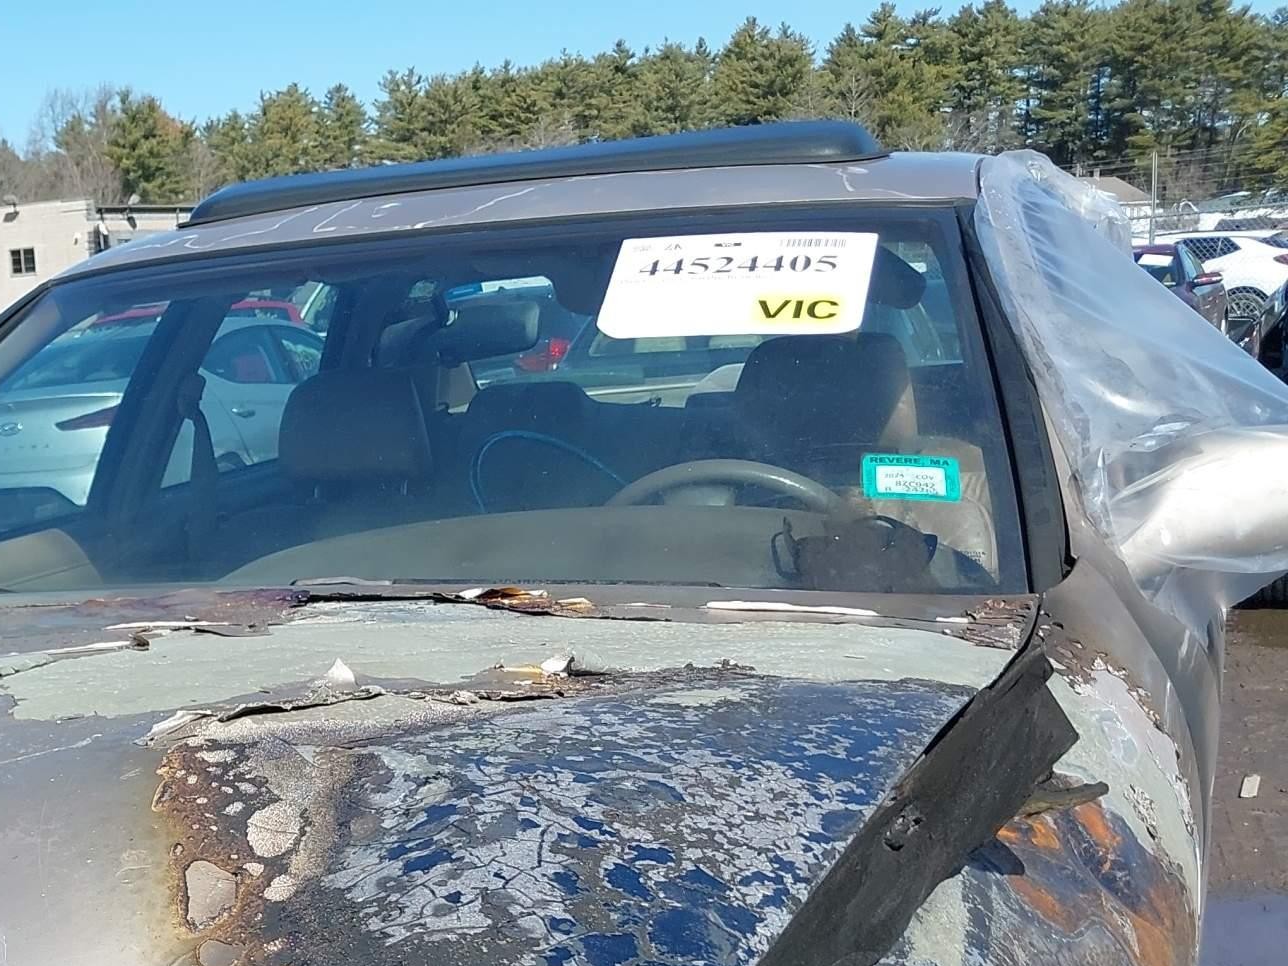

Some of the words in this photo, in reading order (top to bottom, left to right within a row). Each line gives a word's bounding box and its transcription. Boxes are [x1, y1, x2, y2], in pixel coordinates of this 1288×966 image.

[639, 254, 838, 276] 44524405
[758, 299, 840, 320] VIC
[929, 458, 950, 466] MA
